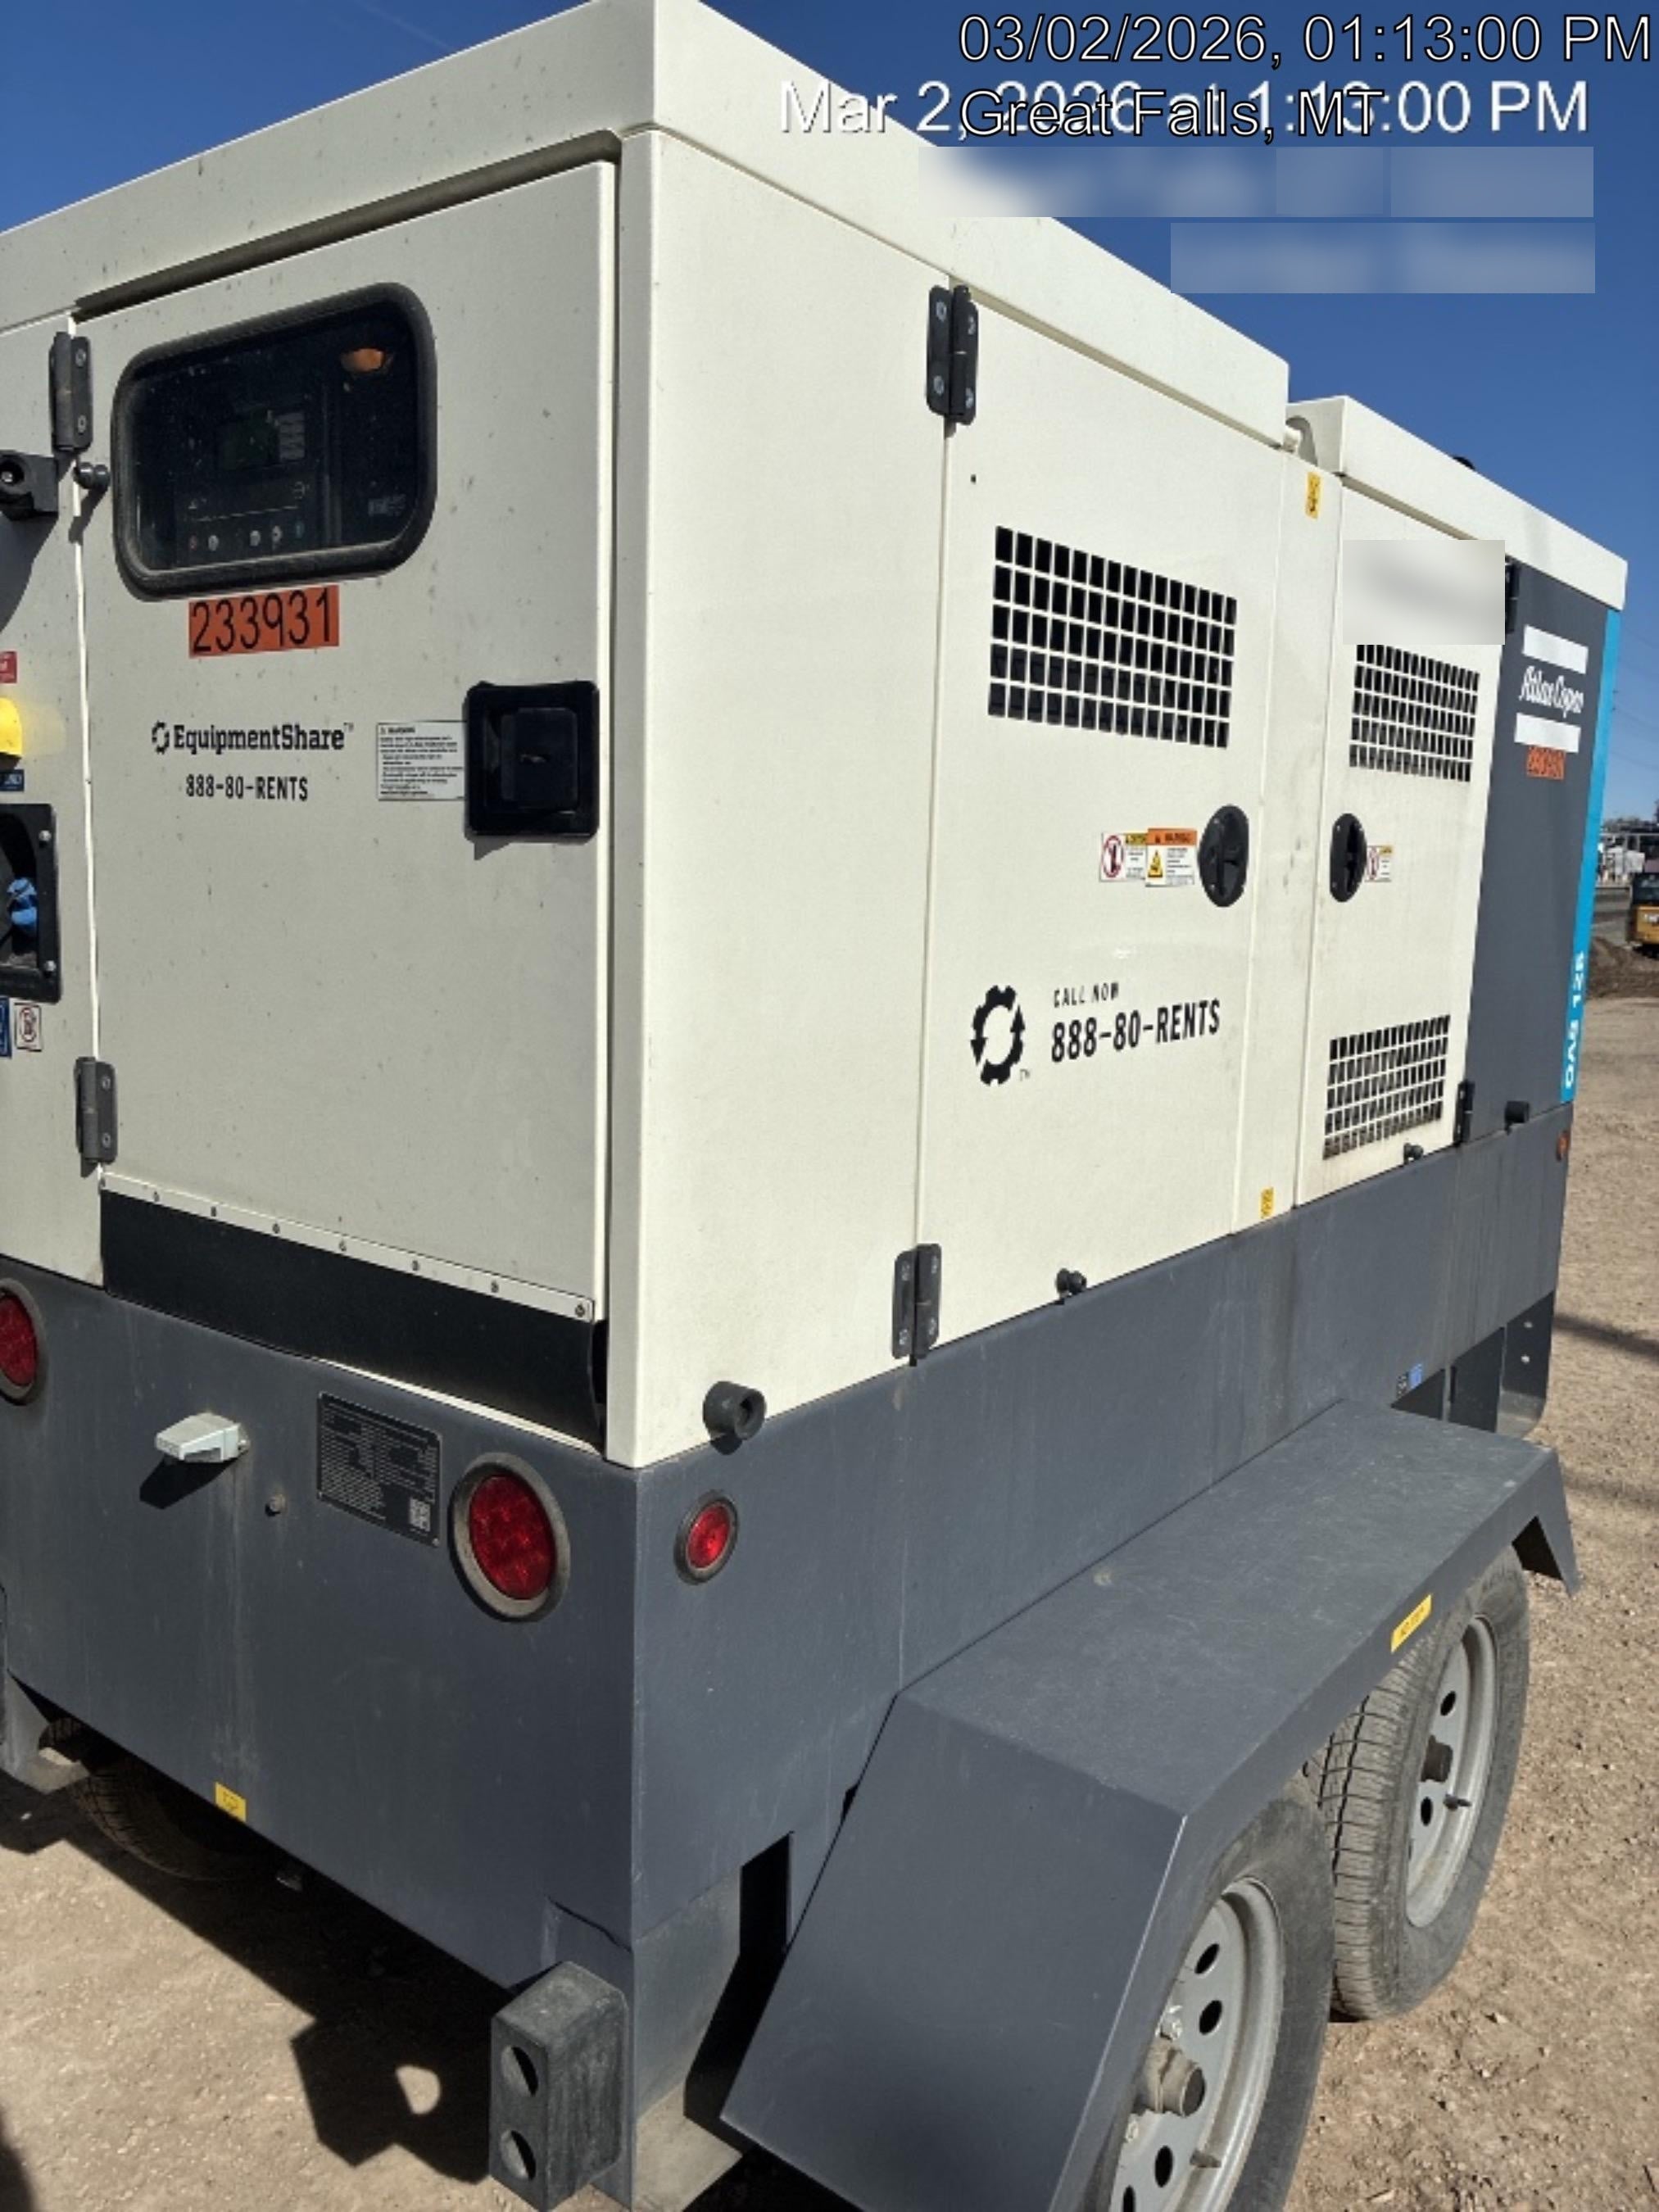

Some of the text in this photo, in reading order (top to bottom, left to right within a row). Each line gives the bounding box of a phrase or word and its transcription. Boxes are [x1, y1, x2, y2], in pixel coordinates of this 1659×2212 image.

[192, 587, 332, 654] 233931
[186, 773, 309, 802] 888-80-RENTS
[1054, 986, 1086, 1009] CALL
[1051, 997, 1220, 1063] 888-80-RENTS
